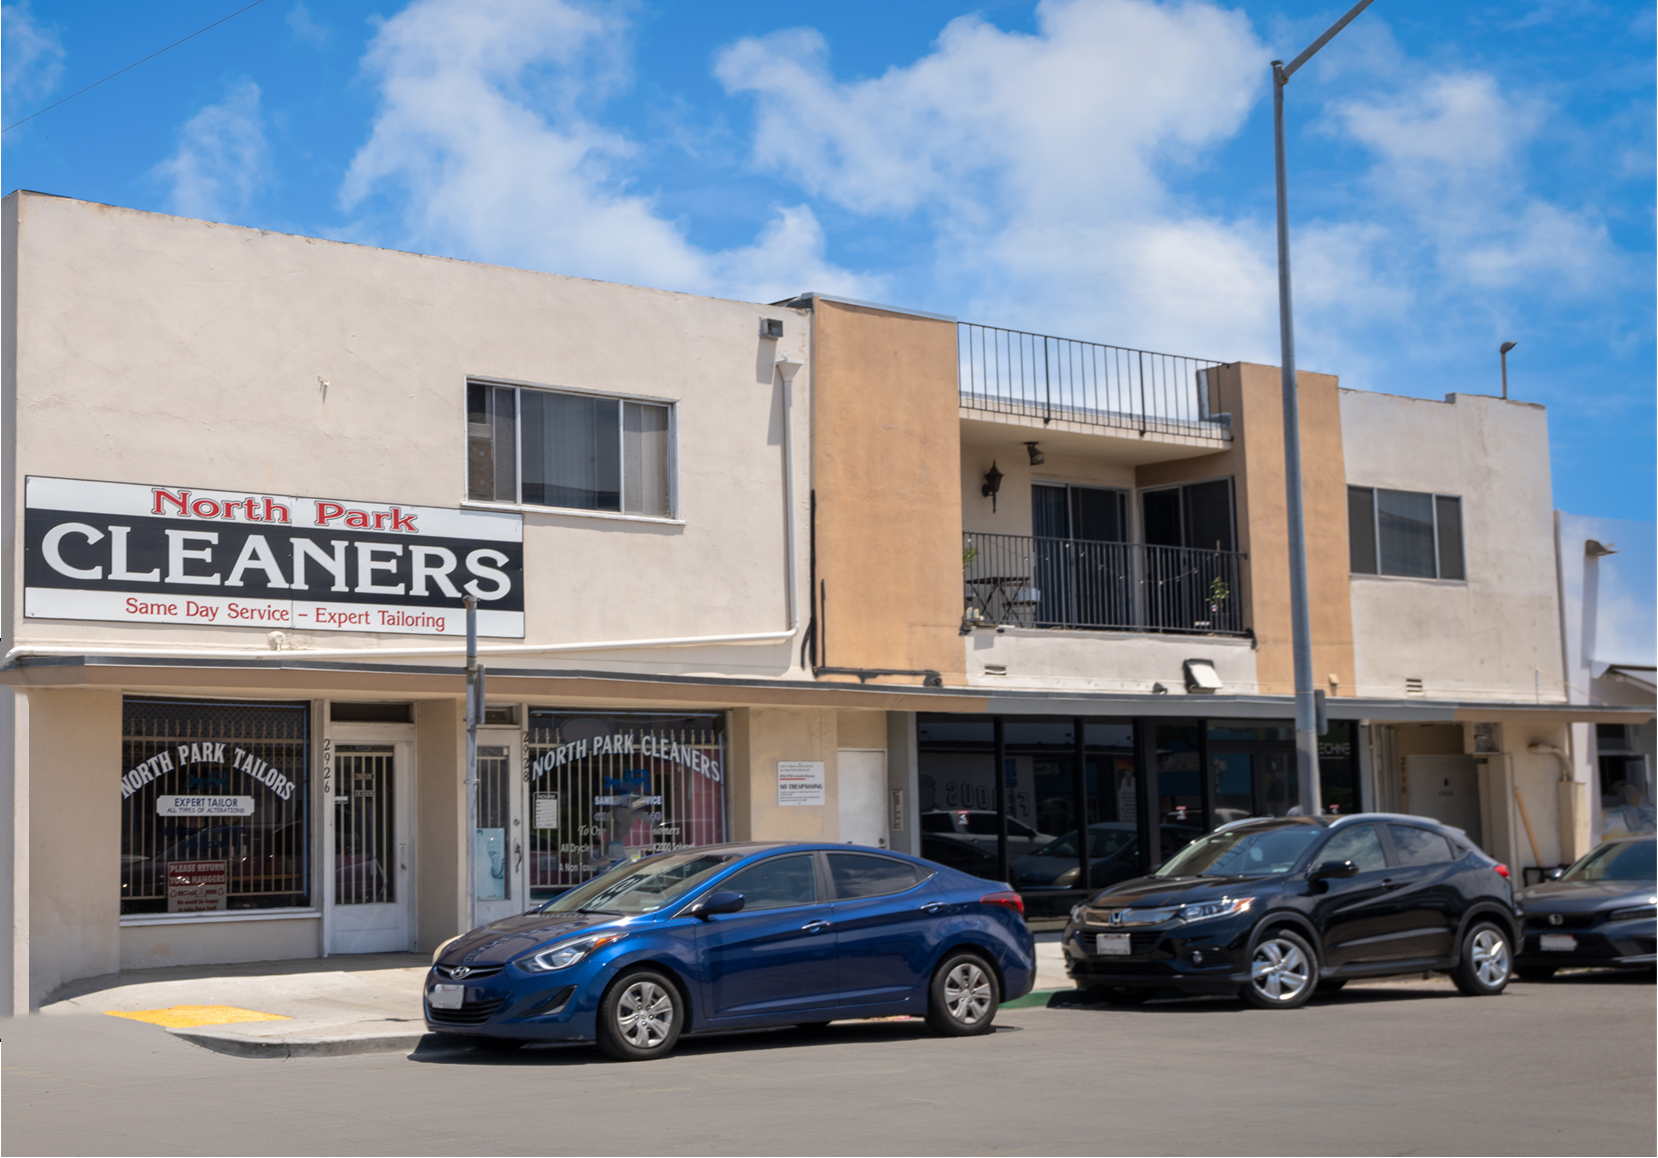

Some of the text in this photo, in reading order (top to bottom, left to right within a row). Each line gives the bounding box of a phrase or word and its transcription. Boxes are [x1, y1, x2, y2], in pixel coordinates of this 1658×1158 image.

[152, 488, 418, 533] North Park
[41, 522, 512, 600] CLEANERS
[126, 597, 178, 616] Same
[186, 601, 219, 621] Day
[228, 603, 290, 621] Service
[315, 608, 371, 627] Expert
[378, 610, 446, 632] Tailoring
[1318, 742, 1351, 755] ECHNE
[531, 734, 721, 783] NORTH PARK CLEANERS
[120, 741, 297, 801] NORTH PARK TAILORS
[323, 738, 331, 793] 2926
[174, 797, 238, 807] EXPERT TAILOR
[594, 795, 615, 806] SAME
[577, 825, 589, 836] To
[560, 843, 569, 853] All
[170, 863, 225, 873] PLEASE RETURN
[558, 863, 564, 872] A
[565, 863, 578, 872] Non
[170, 875, 225, 885] YOUR HANGERS
